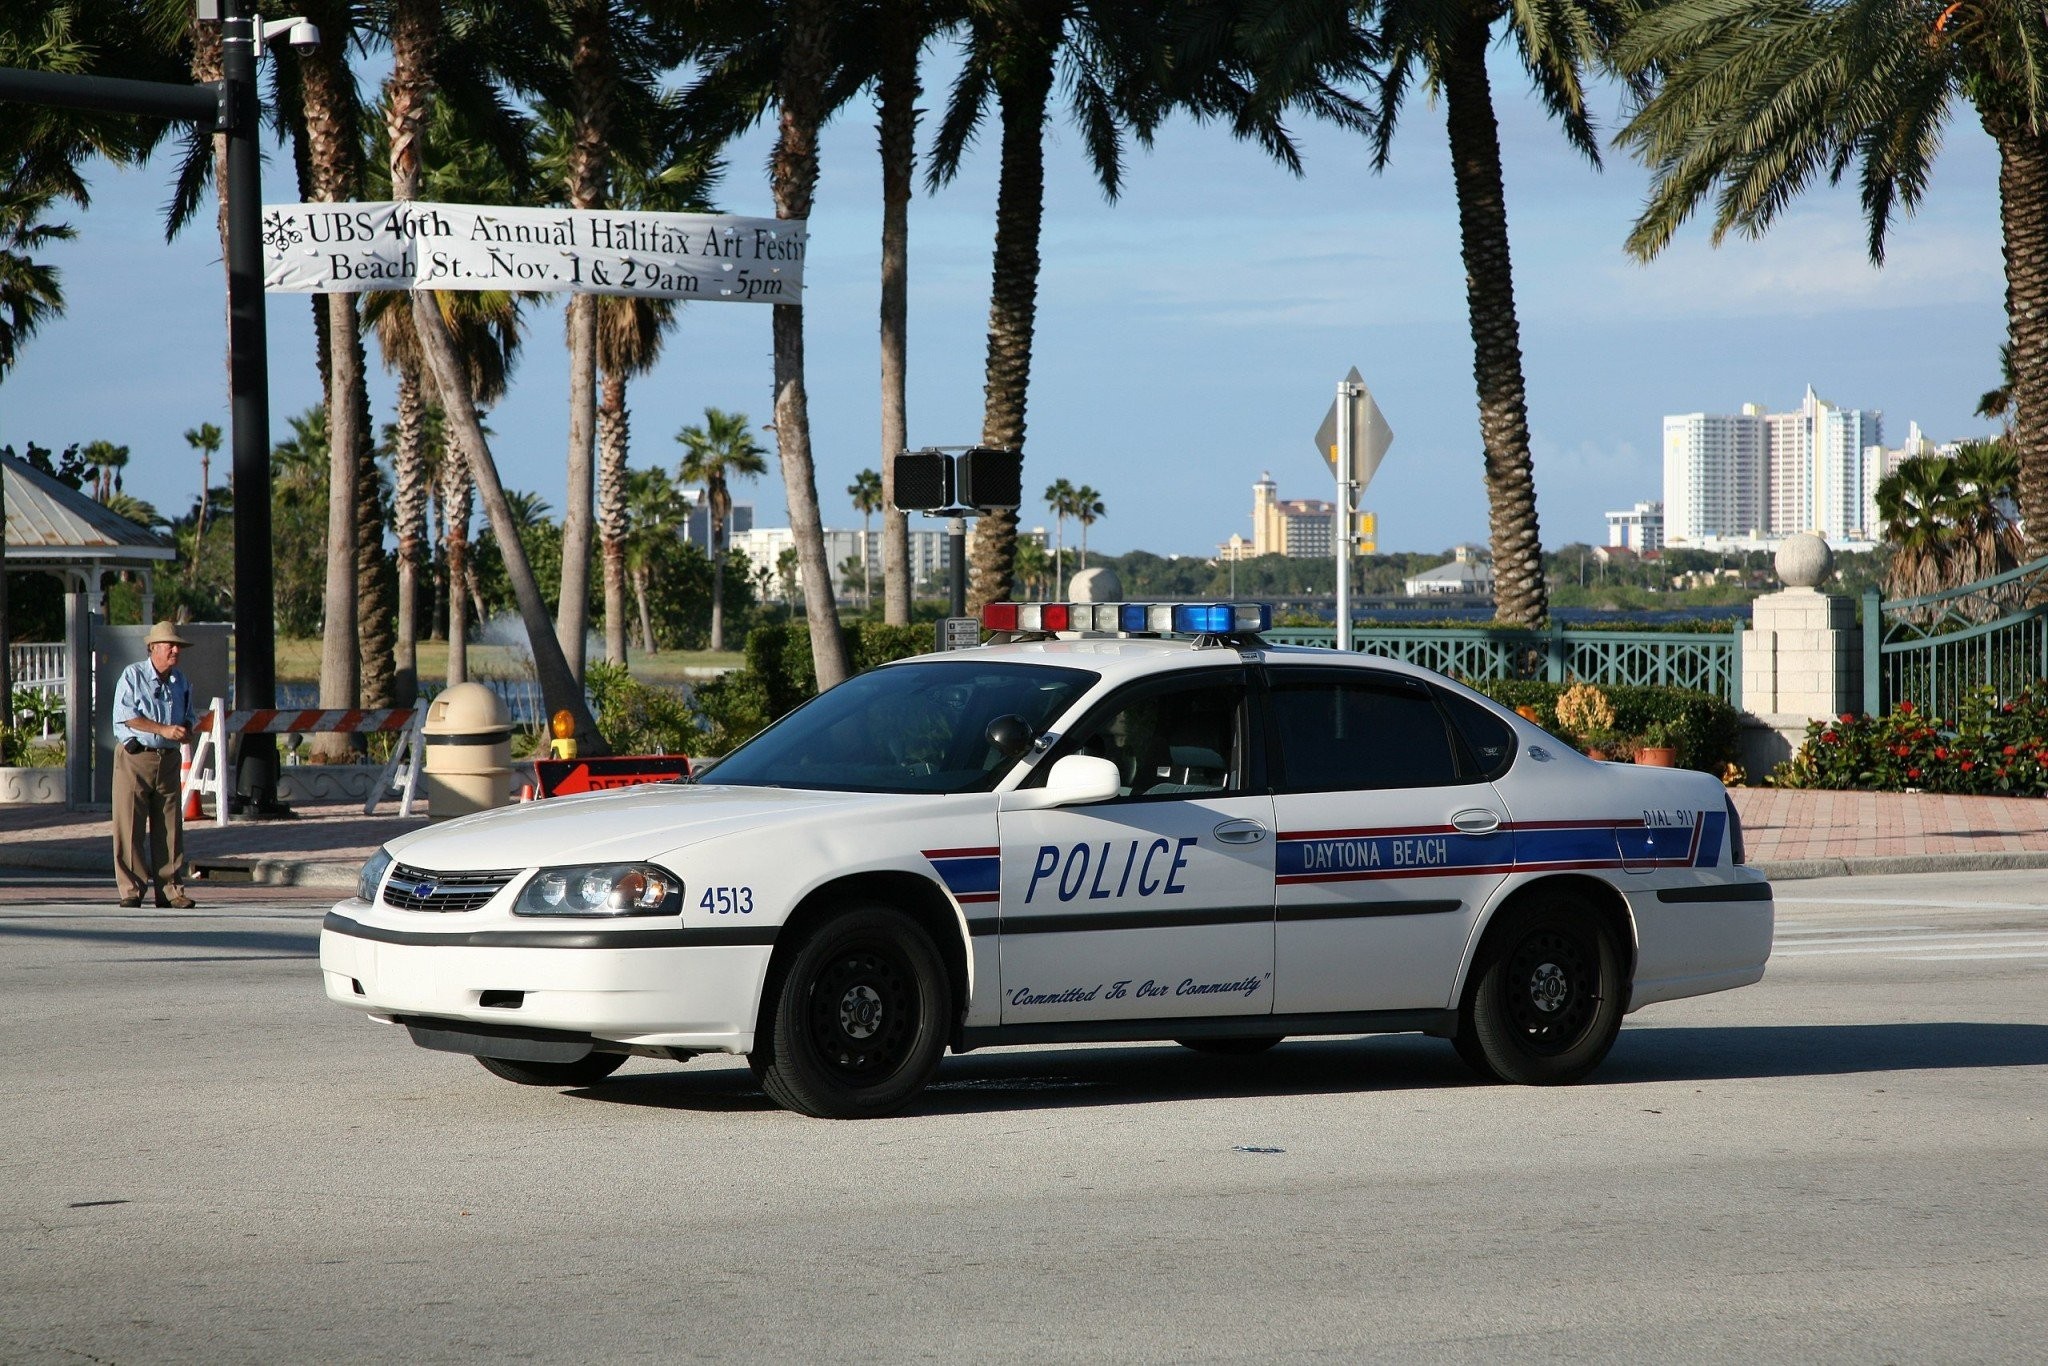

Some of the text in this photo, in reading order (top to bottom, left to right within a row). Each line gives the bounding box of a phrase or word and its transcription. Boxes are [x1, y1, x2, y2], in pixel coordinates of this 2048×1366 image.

[305, 212, 374, 243] UBS
[384, 209, 453, 241] 46th
[470, 214, 576, 246] Annual
[590, 218, 692, 255] Halifax
[702, 226, 743, 258] Art
[329, 252, 417, 280] Beach
[489, 252, 559, 280] Nov.
[570, 257, 584, 283] 1
[591, 260, 612, 286] &
[620, 260, 637, 288] 2
[734, 269, 782, 299] 5pm
[1643, 810, 1695, 826] DIAL 911
[1024, 837, 1198, 904] POLICE
[1303, 839, 1447, 869] DAYTONA BEACH
[699, 886, 754, 914] 4513
[1005, 972, 1271, 1006] "Committed To Our Community"
